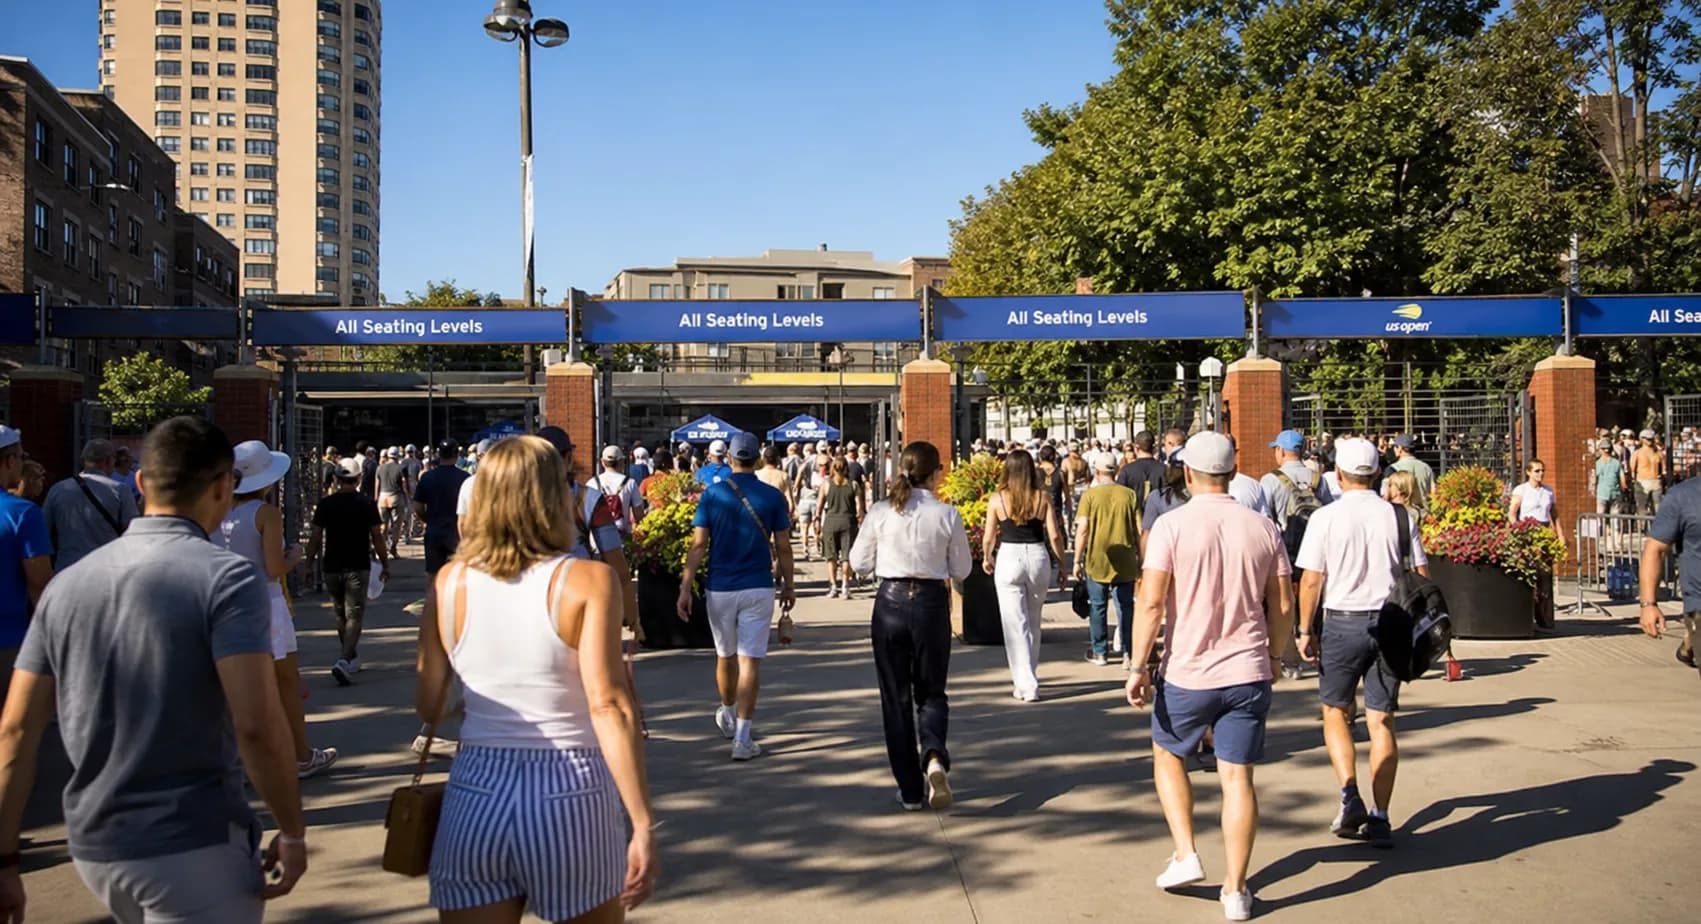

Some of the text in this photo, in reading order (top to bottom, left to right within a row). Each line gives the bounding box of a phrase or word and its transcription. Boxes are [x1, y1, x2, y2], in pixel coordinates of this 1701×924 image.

[678, 312, 824, 331] All Seating Levels
[1006, 309, 1148, 328] All Seating Levels
[1648, 309, 1670, 323] All
[335, 319, 483, 337] All Seating Levels
